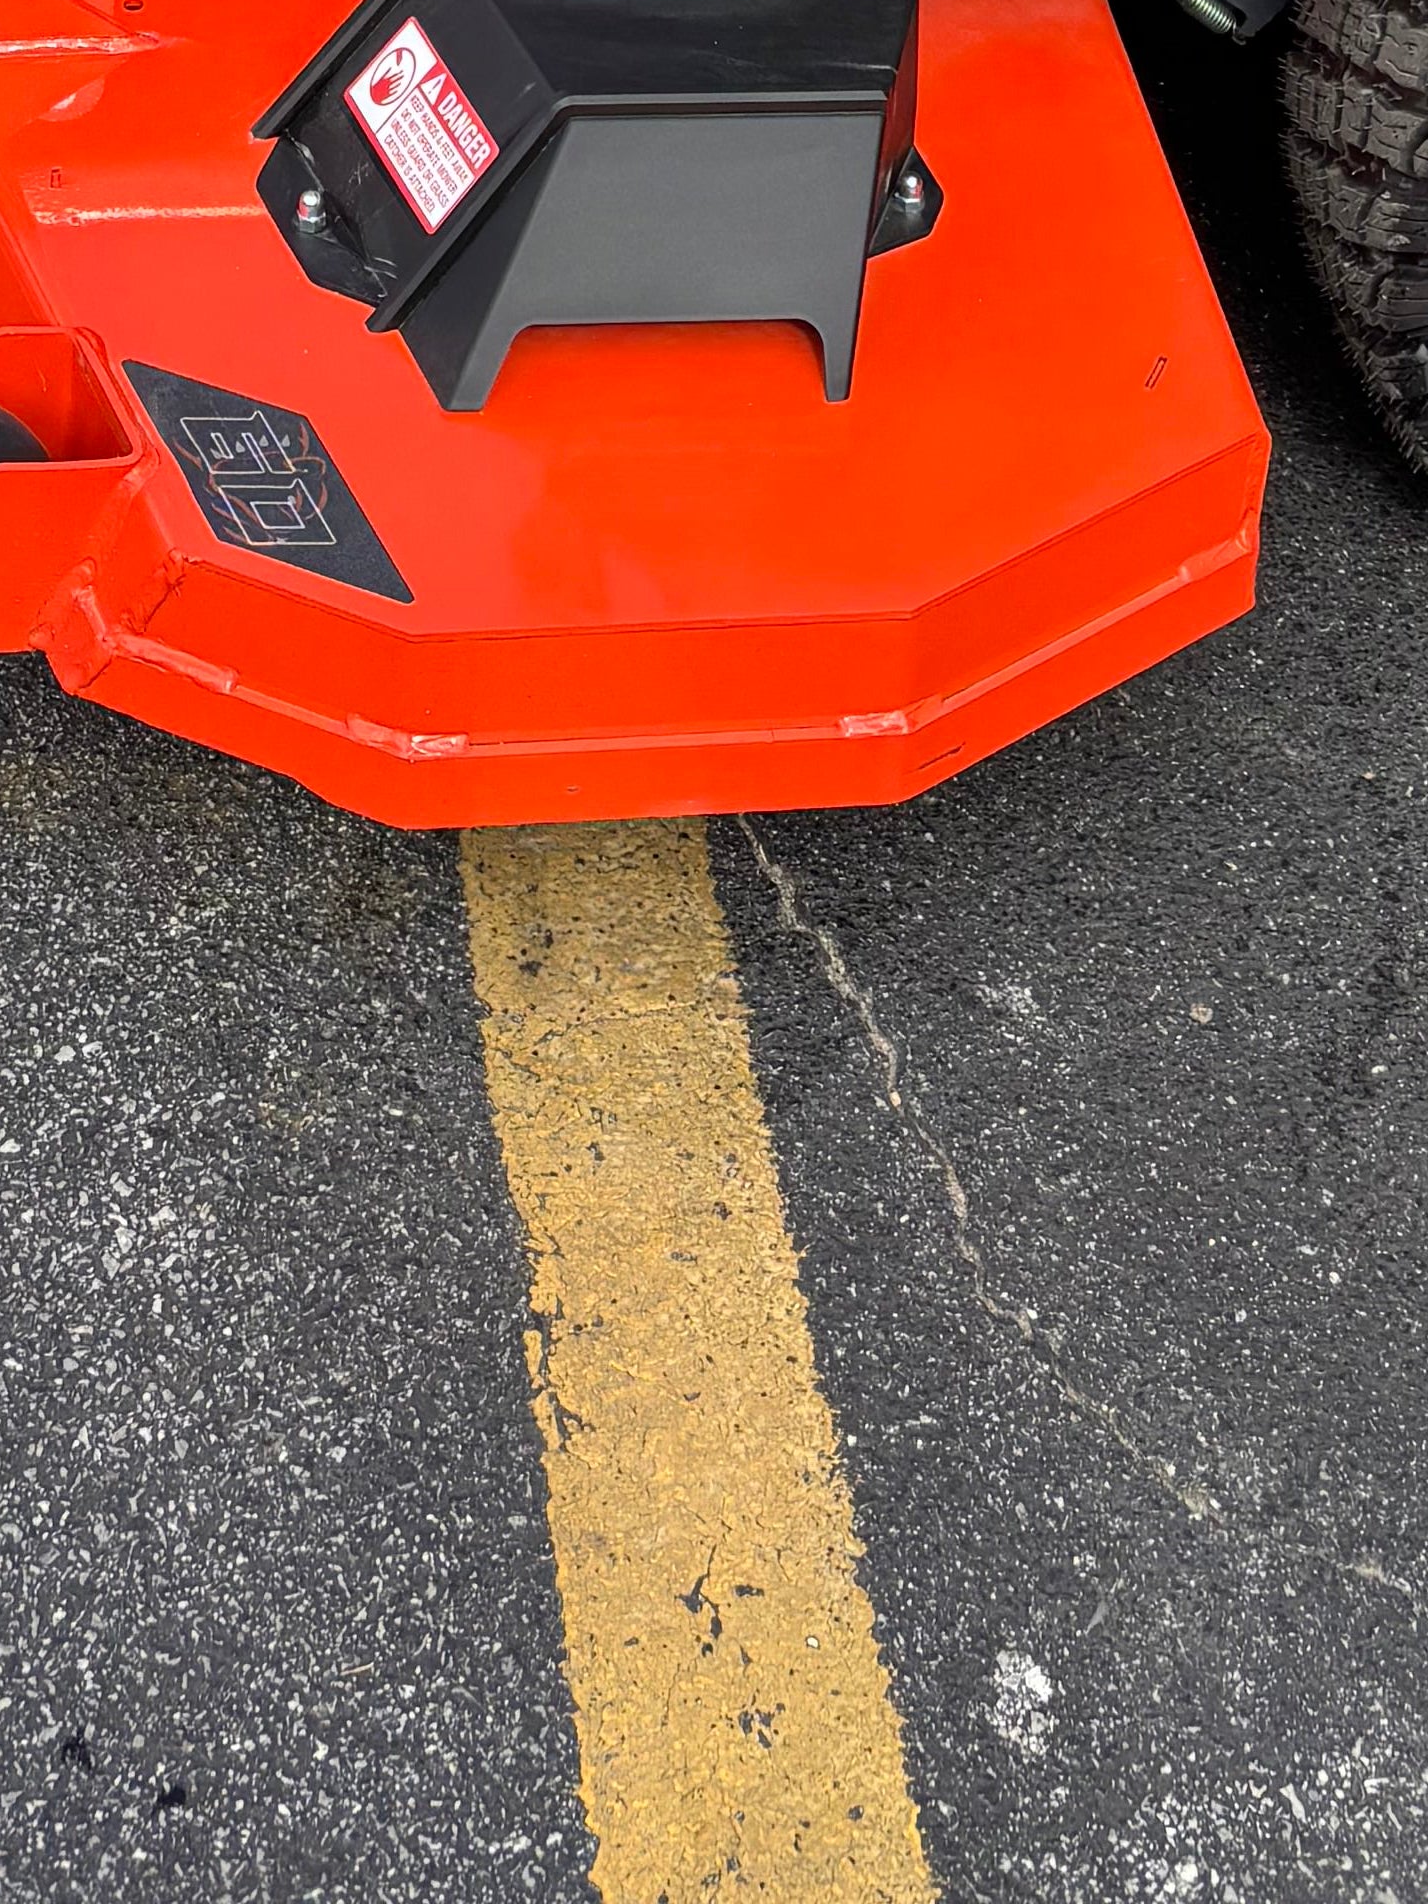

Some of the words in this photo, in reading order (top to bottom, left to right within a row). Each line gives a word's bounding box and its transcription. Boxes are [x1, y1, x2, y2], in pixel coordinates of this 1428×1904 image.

[384, 133, 407, 168] CATCHER
[403, 165, 413, 177] IS
[391, 119, 411, 148] UNLESS
[407, 144, 426, 172] GUARD
[422, 168, 434, 184] OR
[430, 180, 450, 208] GRASS
[401, 107, 412, 122] DO
[408, 119, 421, 136] NOT
[417, 133, 440, 167] OPERATE
[436, 163, 458, 195] MOWER
[411, 94, 425, 113] KEEP
[420, 112, 440, 139] HANDS
[440, 141, 455, 161] FEET
[437, 91, 491, 169] DANGER
